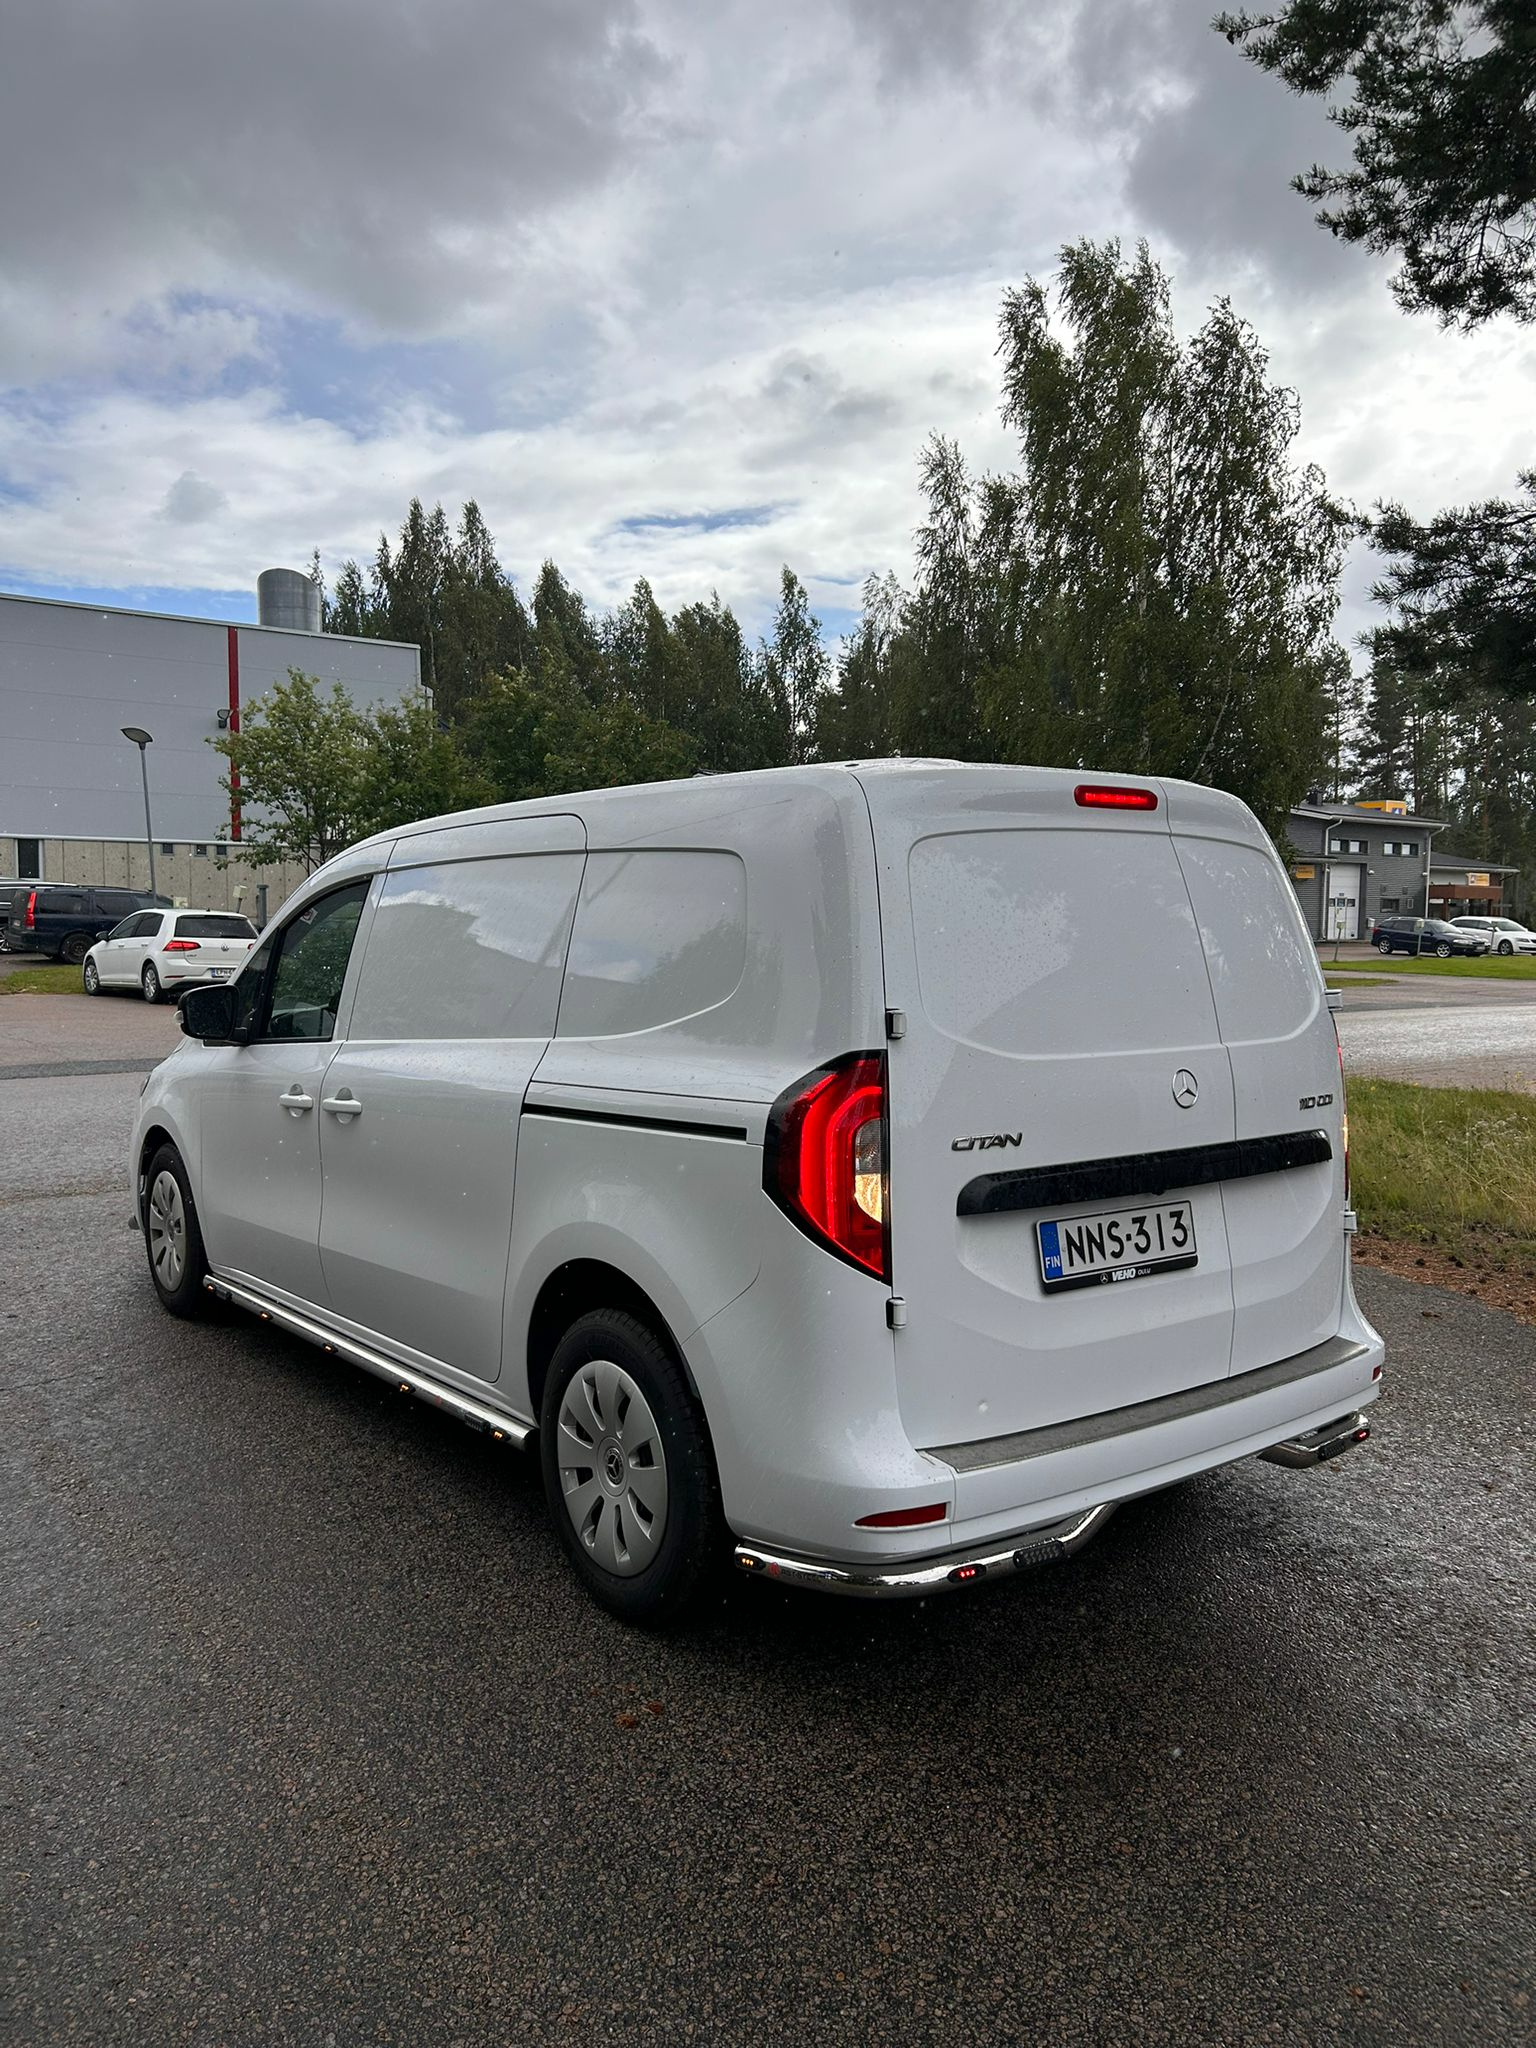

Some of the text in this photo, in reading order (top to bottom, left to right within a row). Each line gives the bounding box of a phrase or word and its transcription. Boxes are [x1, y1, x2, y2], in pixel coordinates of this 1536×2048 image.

[951, 1132, 1022, 1151] CITAN
[1065, 1210, 1188, 1267] NNS-313
[1045, 1255, 1061, 1269] FIN
[1112, 1268, 1136, 1281] VEHO
